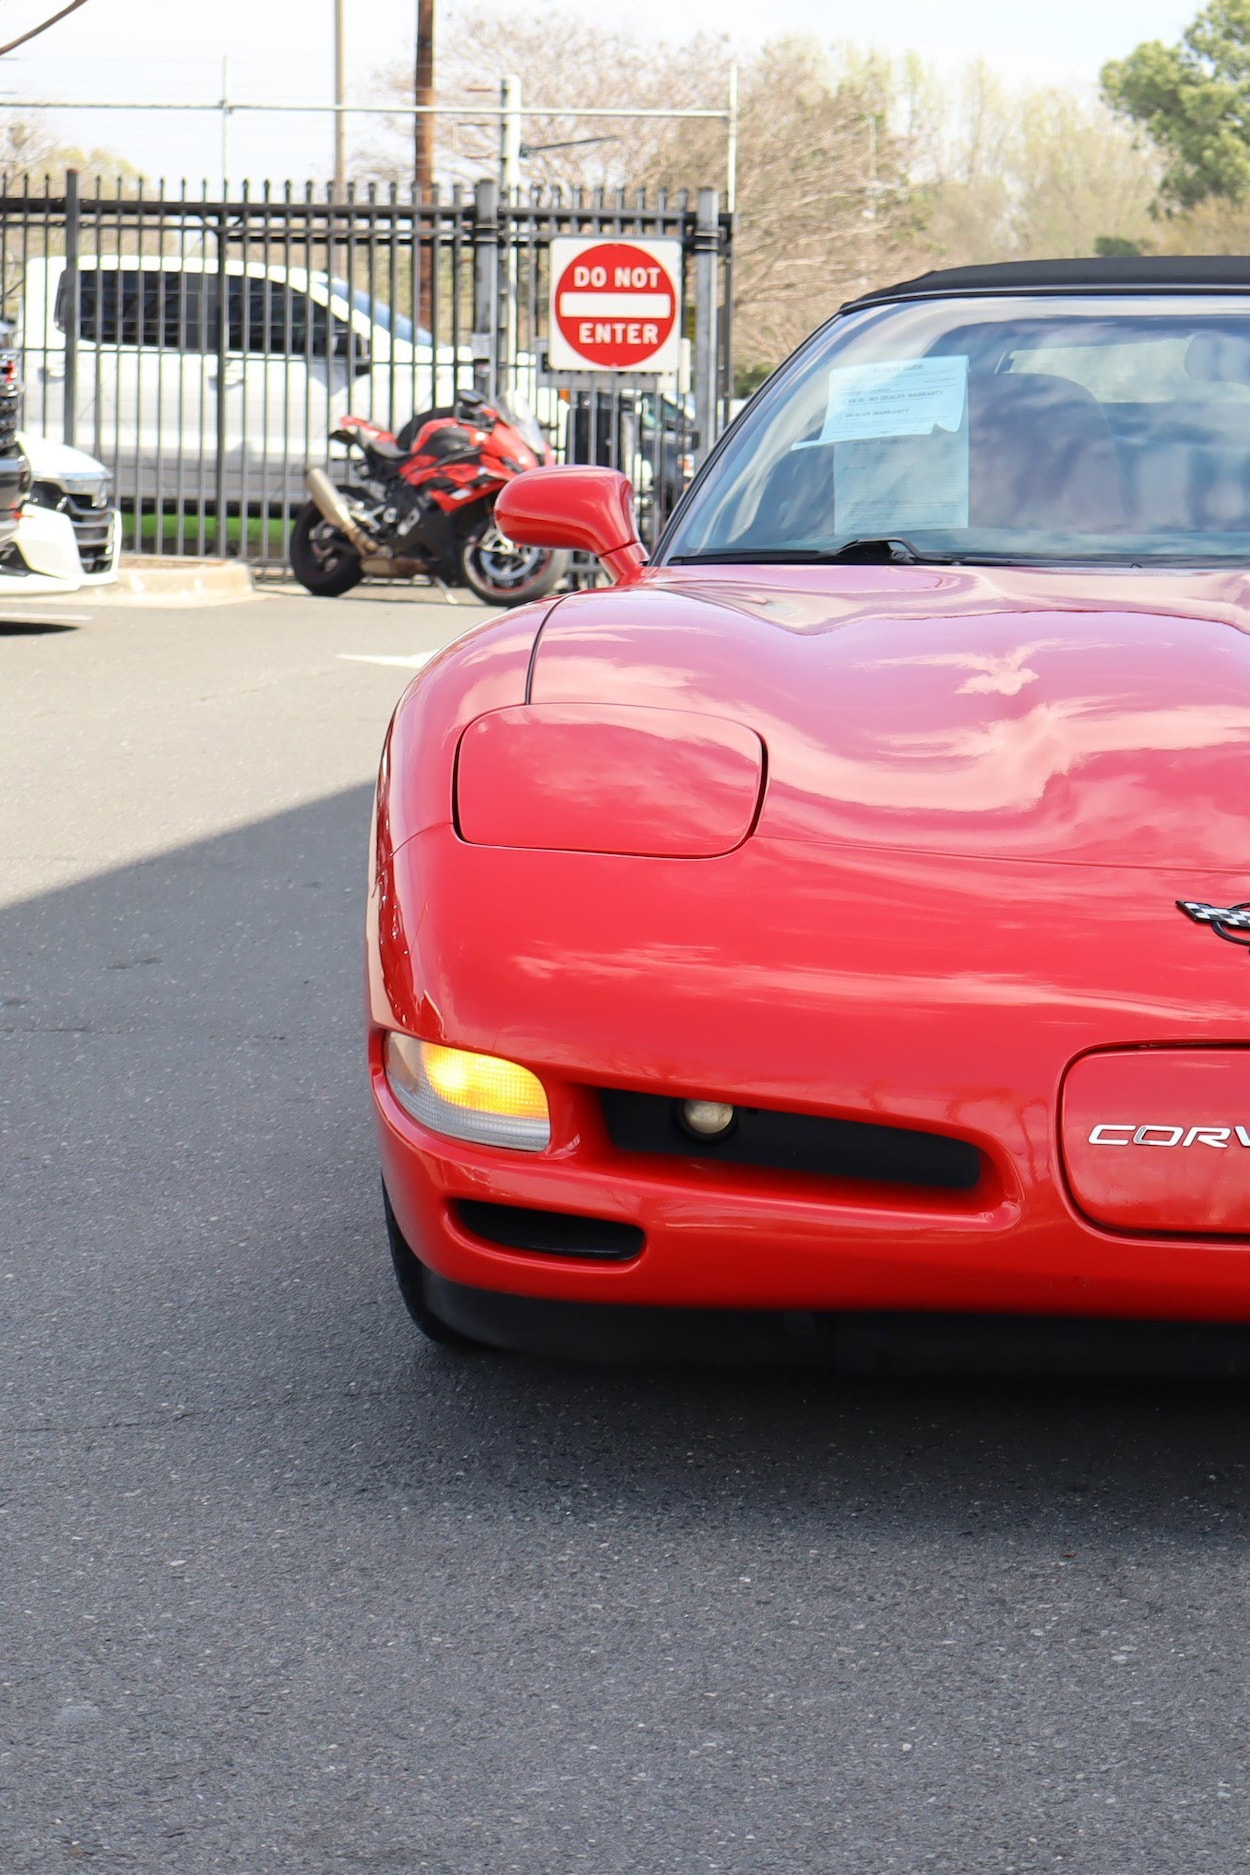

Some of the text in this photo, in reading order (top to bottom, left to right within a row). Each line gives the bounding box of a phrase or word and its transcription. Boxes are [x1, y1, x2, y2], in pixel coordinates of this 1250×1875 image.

[574, 266, 661, 288] DO NOT
[579, 322, 659, 344] ENTER
